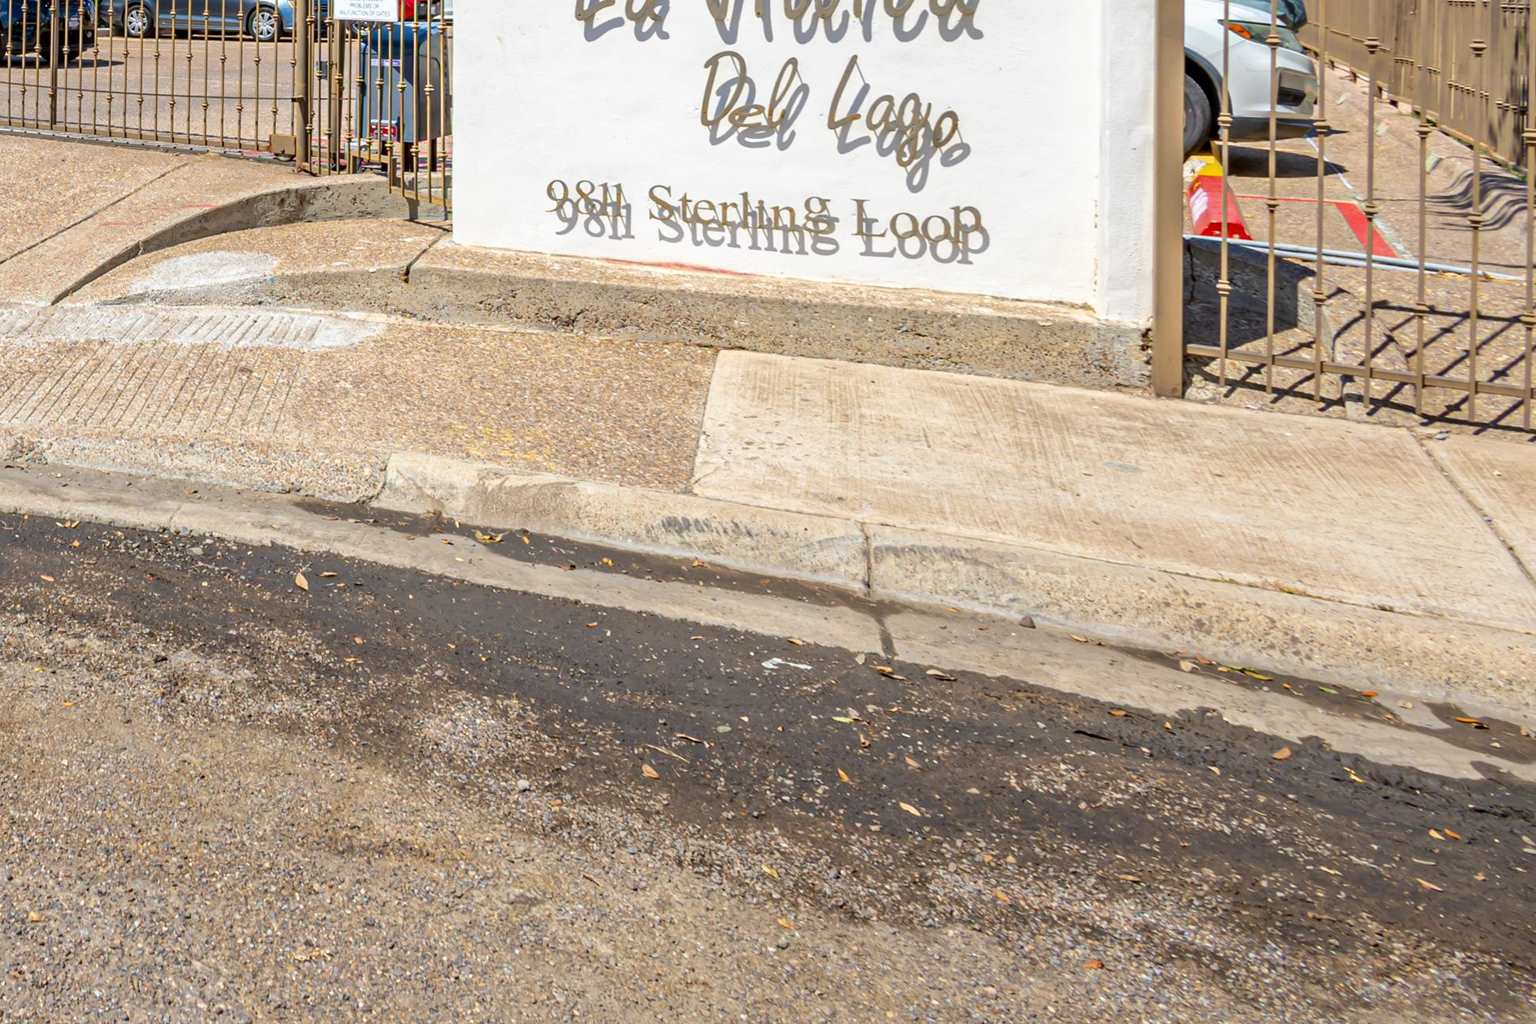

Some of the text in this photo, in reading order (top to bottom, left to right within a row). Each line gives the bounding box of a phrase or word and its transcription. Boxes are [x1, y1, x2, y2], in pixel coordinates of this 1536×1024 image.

[701, 51, 960, 168] Del Lago
[545, 180, 983, 244] 9811 Sterling Loop
